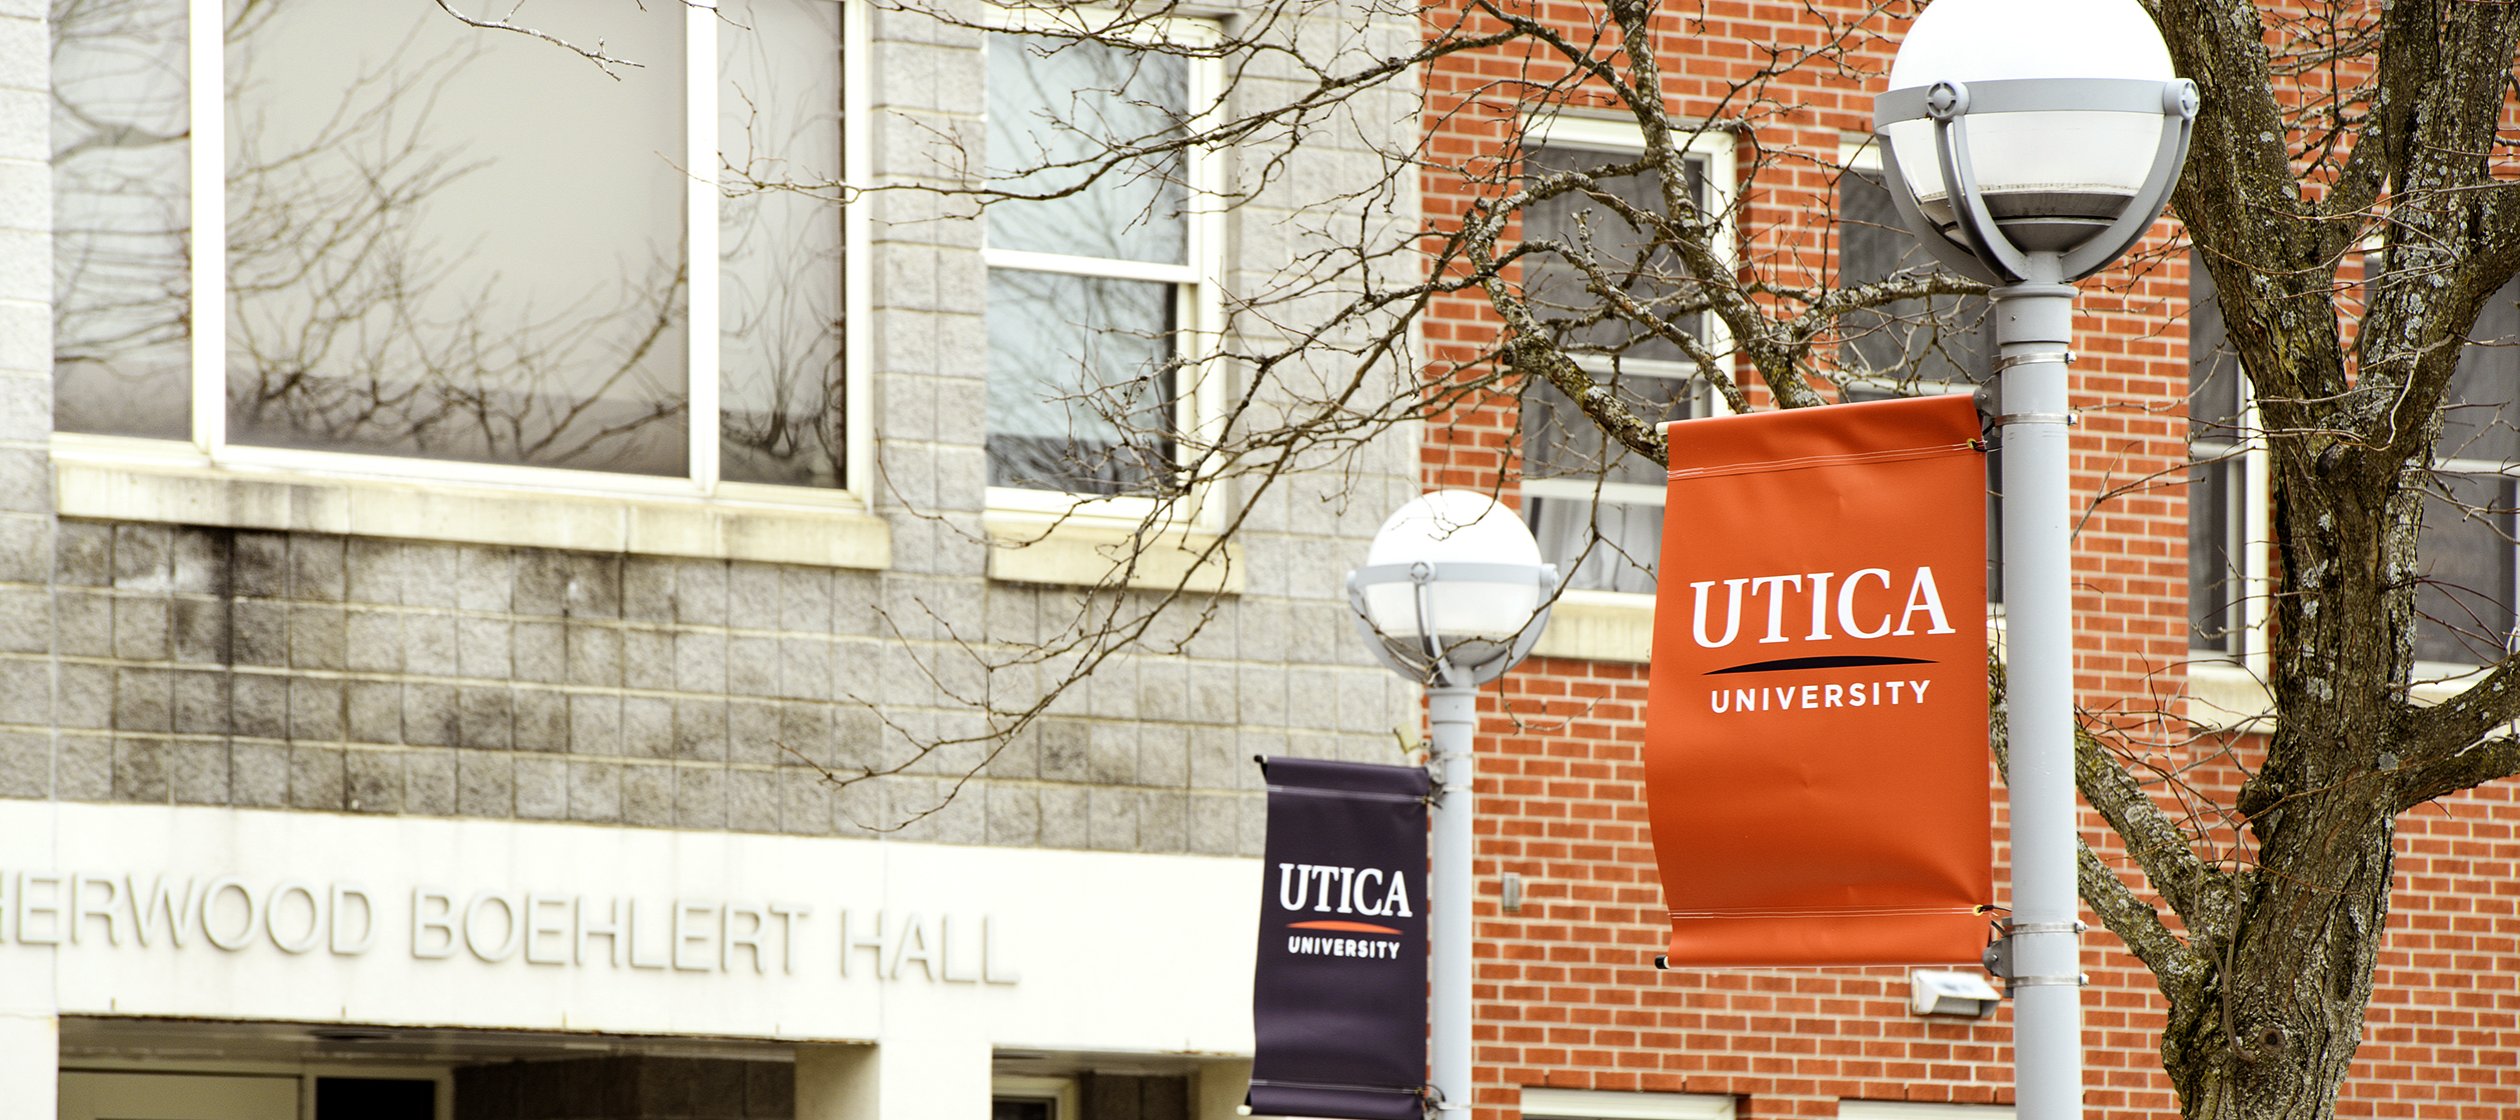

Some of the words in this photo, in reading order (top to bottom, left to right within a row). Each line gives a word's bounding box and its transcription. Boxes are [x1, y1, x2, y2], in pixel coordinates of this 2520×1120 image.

[1689, 566, 1956, 648] UTICA
[1711, 679, 1931, 713] UNIVERSITY
[1279, 862, 1413, 918] UTICA
[412, 885, 811, 976] BOEHLERT
[841, 908, 1022, 986] HALL
[1288, 936, 1400, 960] UNIVERSITY
